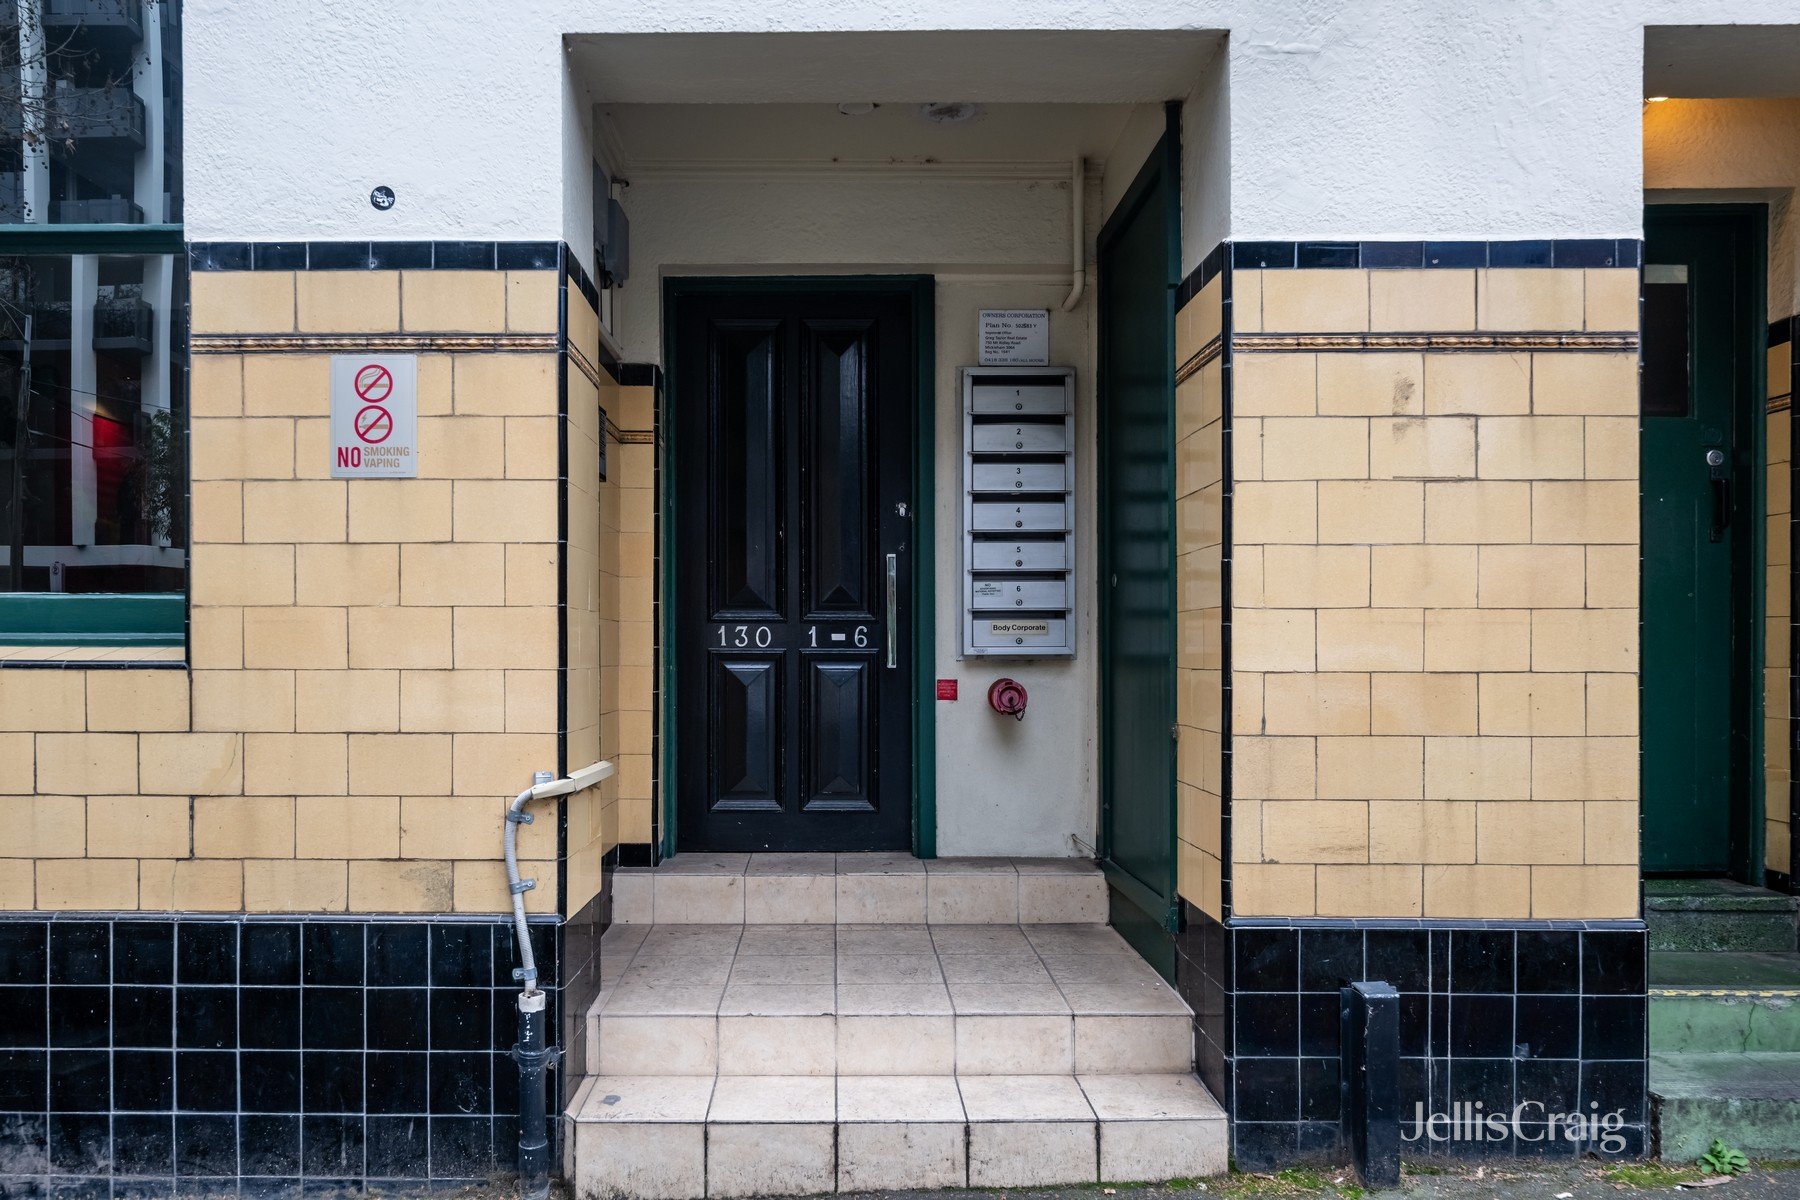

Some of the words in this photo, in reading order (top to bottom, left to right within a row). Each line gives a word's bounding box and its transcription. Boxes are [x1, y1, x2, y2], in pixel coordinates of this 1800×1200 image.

[338, 447, 361, 468] NO
[364, 446, 410, 456] SMOKING
[364, 458, 400, 468] VAPING
[718, 626, 772, 648] 130
